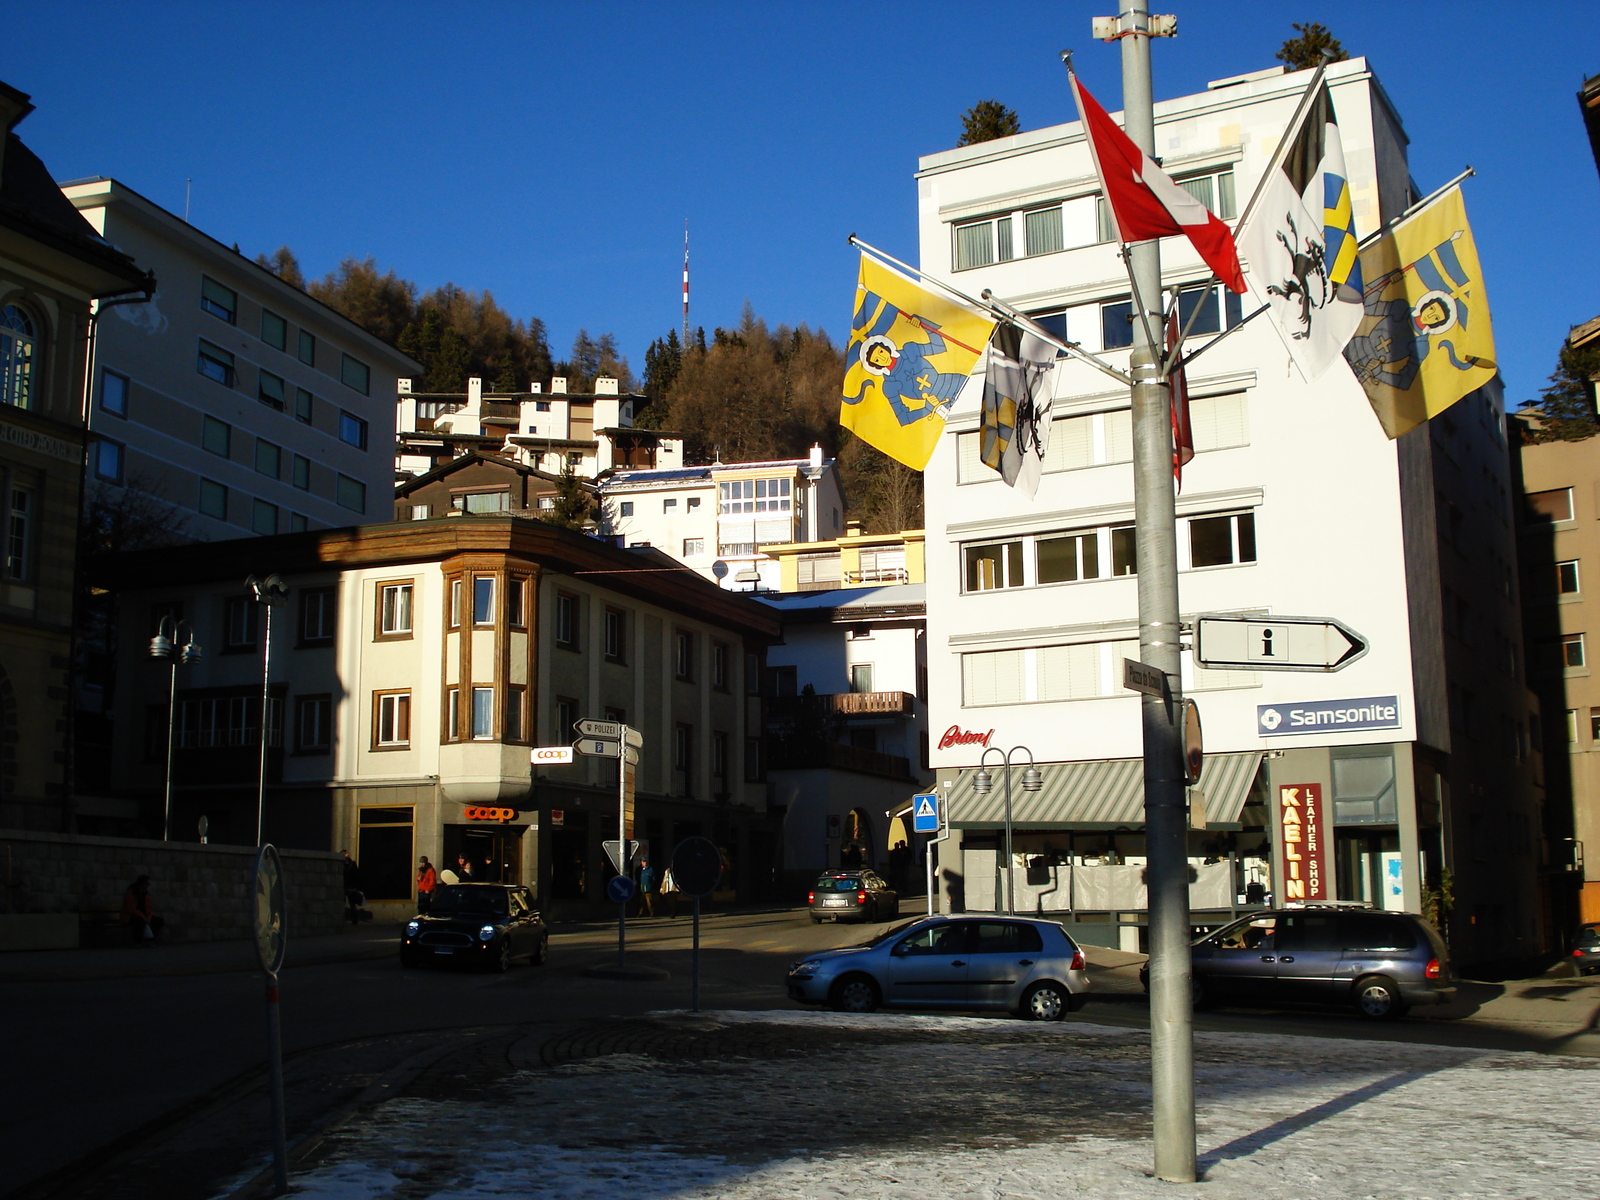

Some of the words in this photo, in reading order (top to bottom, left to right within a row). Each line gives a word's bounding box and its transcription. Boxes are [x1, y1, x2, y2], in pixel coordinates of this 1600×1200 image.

[1290, 704, 1396, 726] Samsonite
[594, 724, 615, 734] POLIZEI
[538, 750, 567, 760] coop
[464, 806, 514, 823] coop
[1281, 788, 1305, 898] KAELIN
